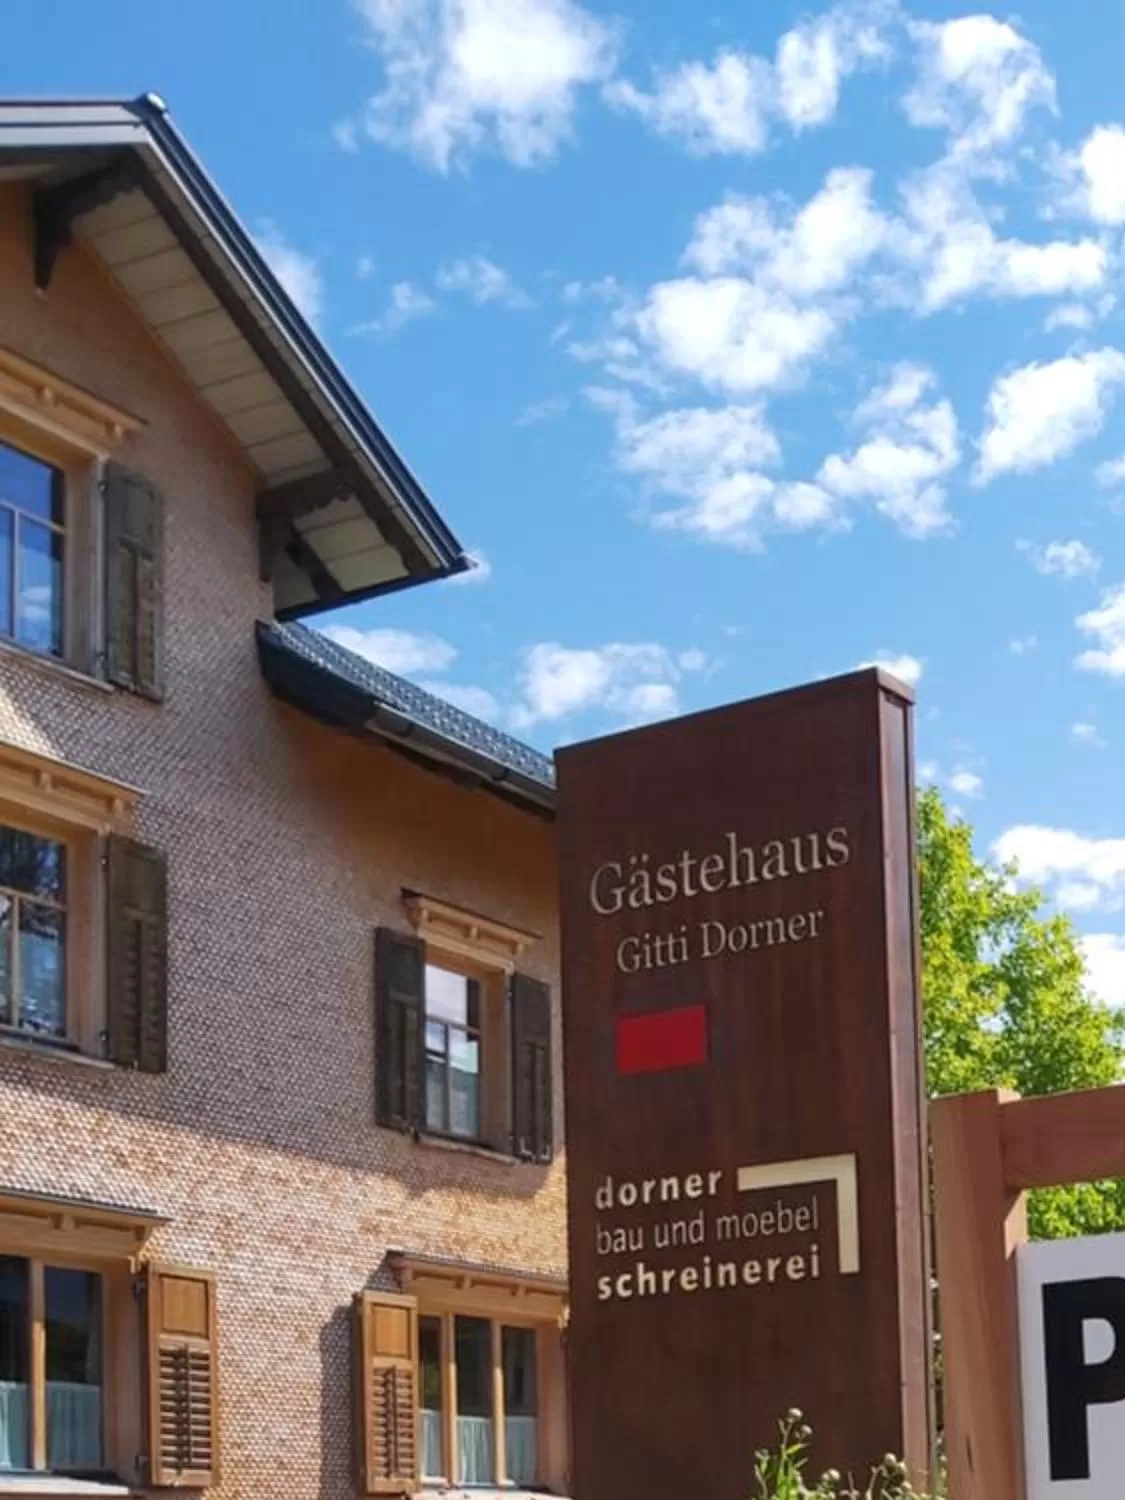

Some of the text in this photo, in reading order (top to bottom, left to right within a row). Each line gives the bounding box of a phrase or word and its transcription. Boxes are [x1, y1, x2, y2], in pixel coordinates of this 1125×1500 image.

[590, 824, 850, 915] Gästehaus
[616, 907, 825, 974] Gitti Dorner
[595, 1169, 723, 1209] dorner
[597, 1195, 819, 1255] bau und moebel
[598, 1244, 821, 1300] schreinerei
